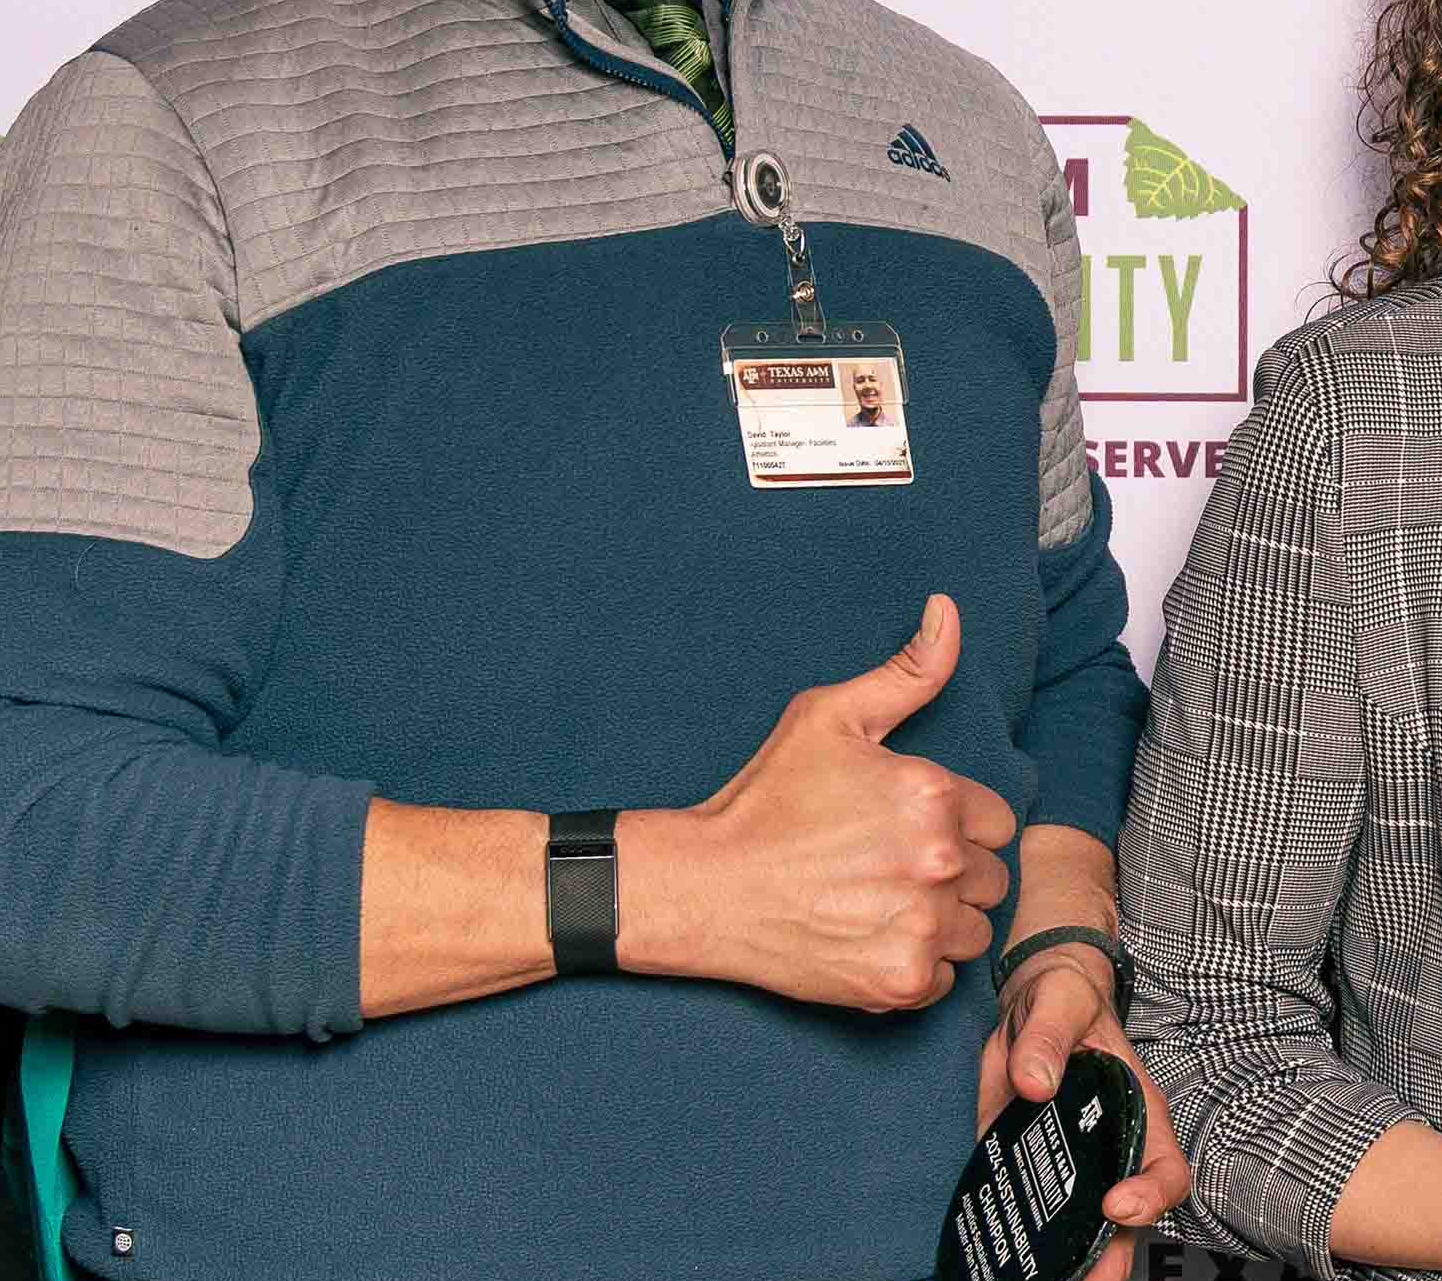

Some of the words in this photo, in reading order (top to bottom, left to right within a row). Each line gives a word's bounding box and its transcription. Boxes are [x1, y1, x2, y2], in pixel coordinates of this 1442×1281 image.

[768, 366, 804, 378] TEXAS
[1042, 1111, 1060, 1147] TEXAS
[985, 1133, 1004, 1172] 2024
[1026, 1124, 1063, 1210] SUSTAINABILITY
[978, 1184, 1011, 1267] CHAMPION
[993, 1166, 1038, 1281] SUSTAINABILITY
[963, 1245, 976, 1271] Plan
